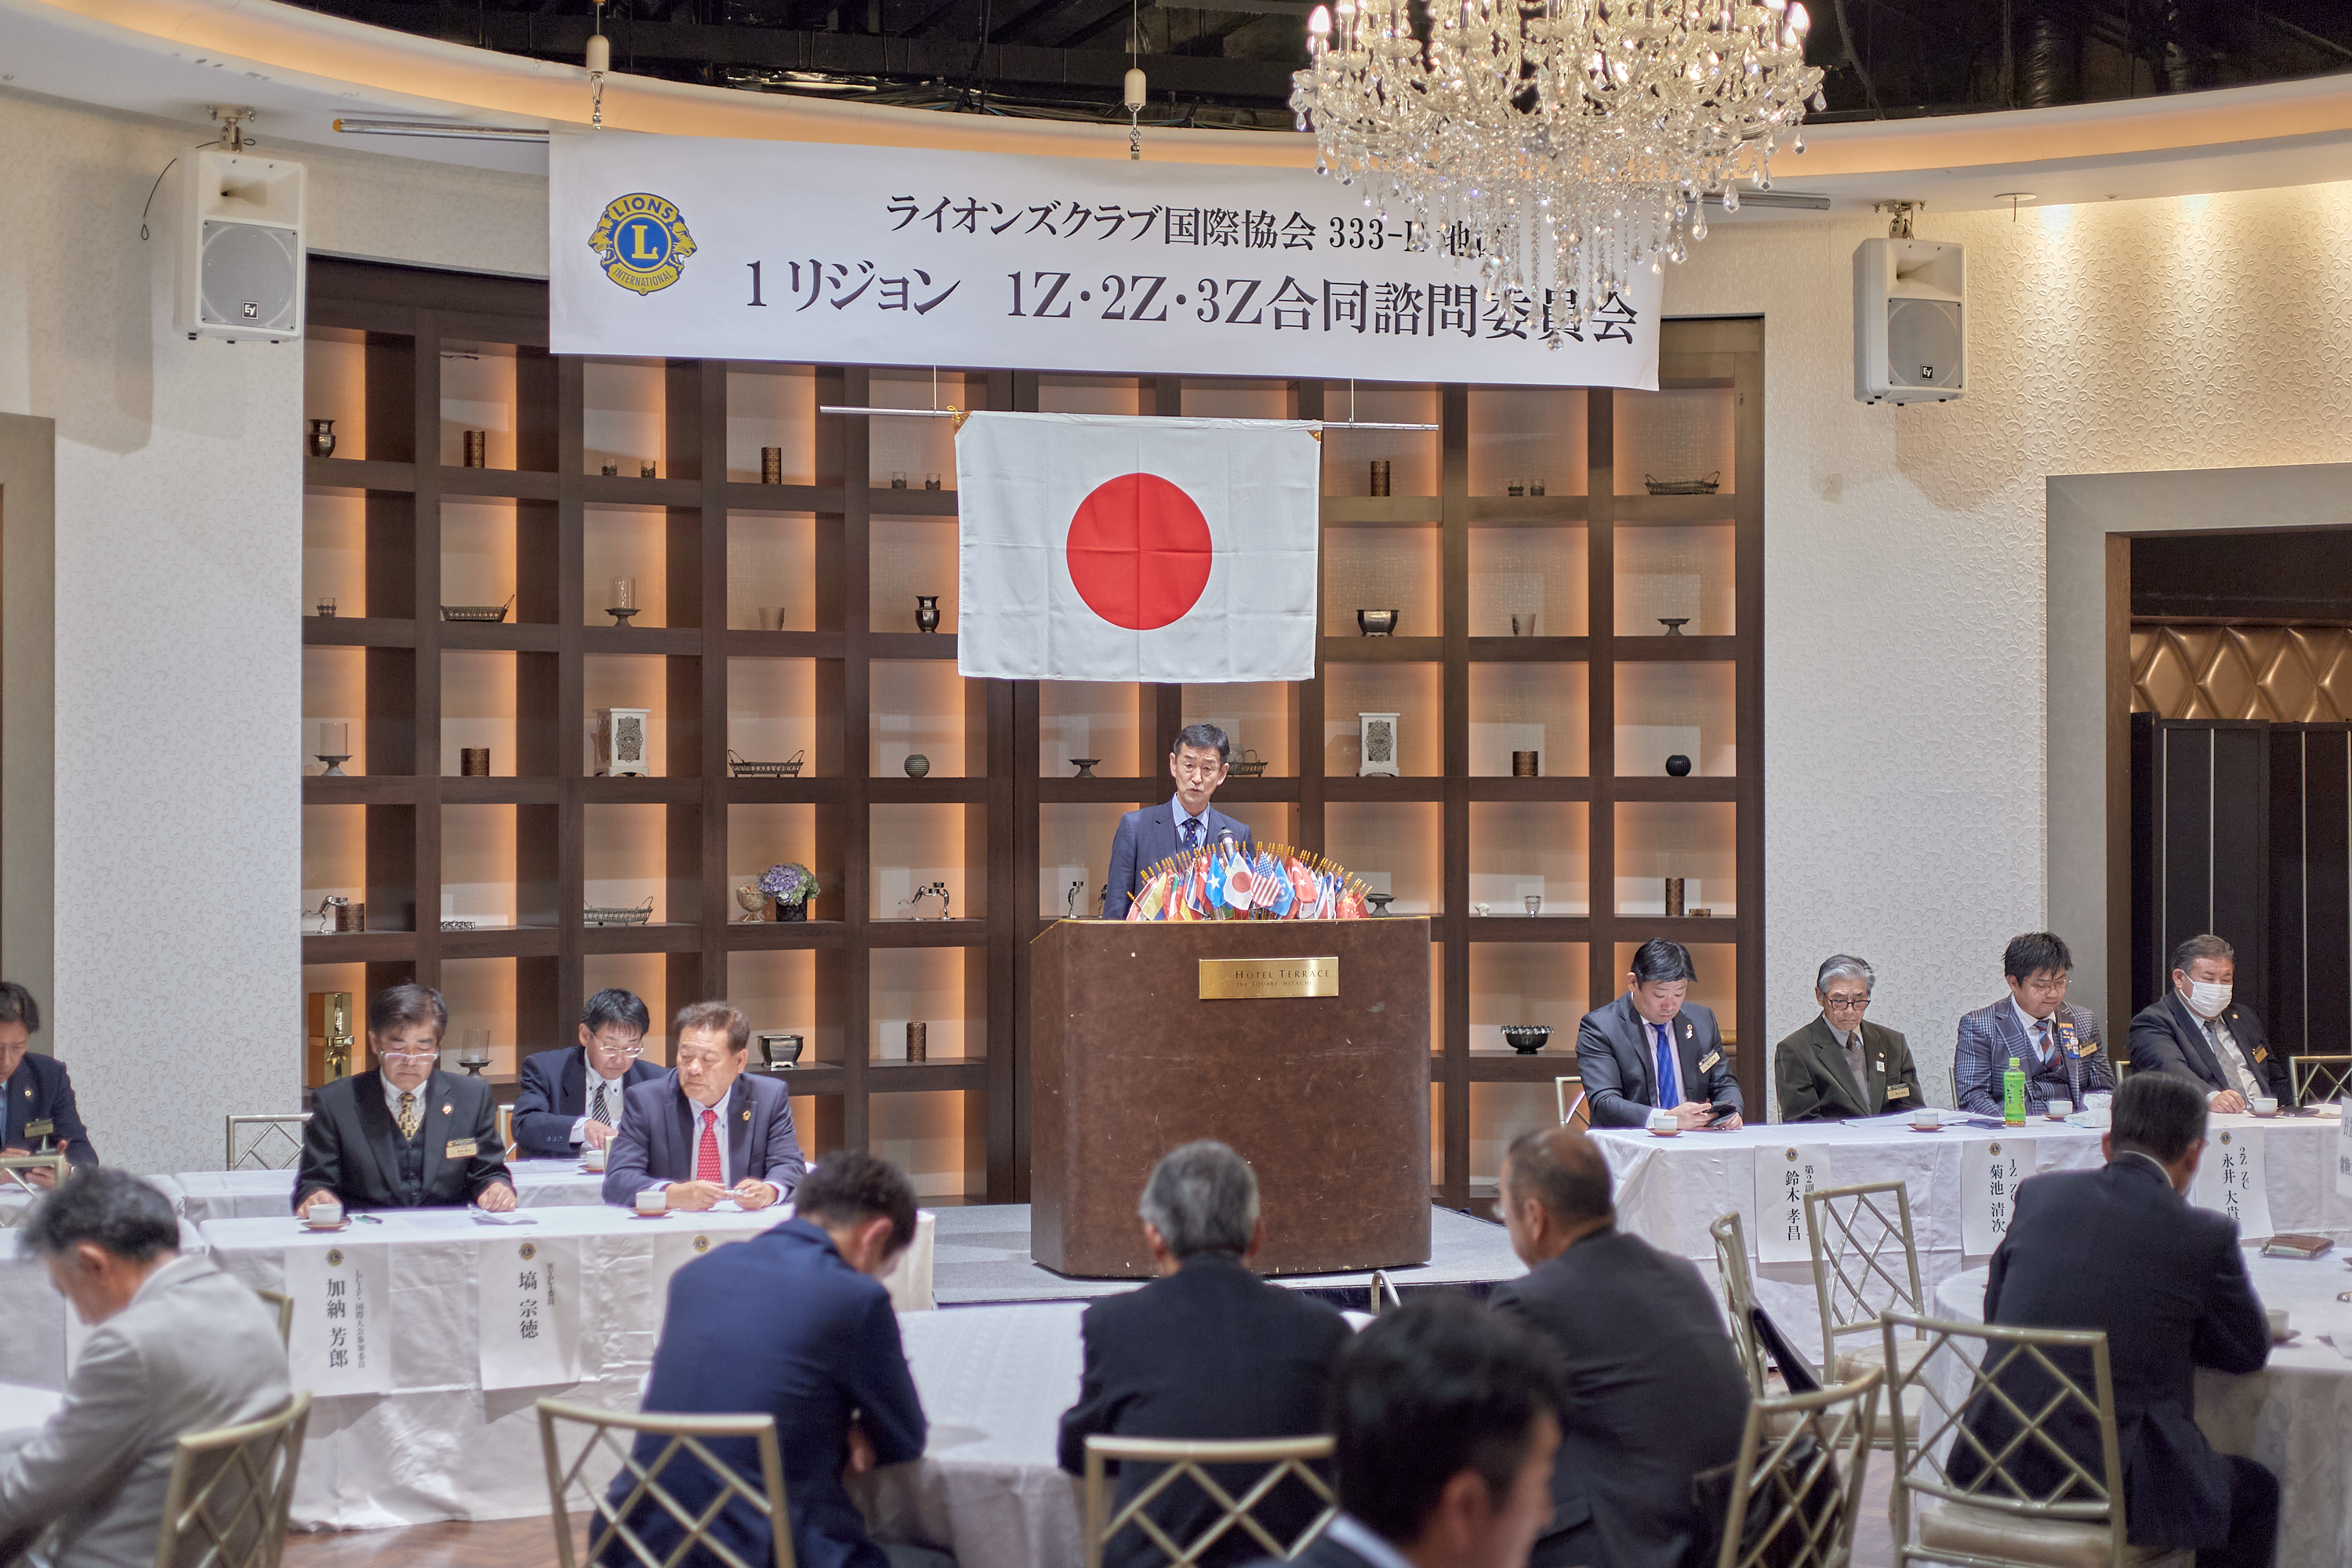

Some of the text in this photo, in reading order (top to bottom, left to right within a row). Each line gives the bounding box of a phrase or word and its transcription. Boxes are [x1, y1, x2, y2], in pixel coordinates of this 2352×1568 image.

[612, 197, 673, 220] LIONS
[632, 224, 659, 260] L
[613, 267, 673, 287] INTERNATIONAL
[1236, 970, 1330, 979] HOTEL TERRACE
[1805, 1164, 1815, 1193] 第2副
[2009, 1159, 2017, 1177] 1Z
[2221, 1153, 2240, 1220] 永井 大貴
[2239, 1146, 2250, 1190] 2Z ZC
[1785, 1171, 1801, 1241] 鈴木 孝昌
[1989, 1164, 2006, 1233] 菊池 清次
[325, 1278, 348, 1368] 加納 芳郎
[518, 1271, 539, 1339] 塙 宗徳
